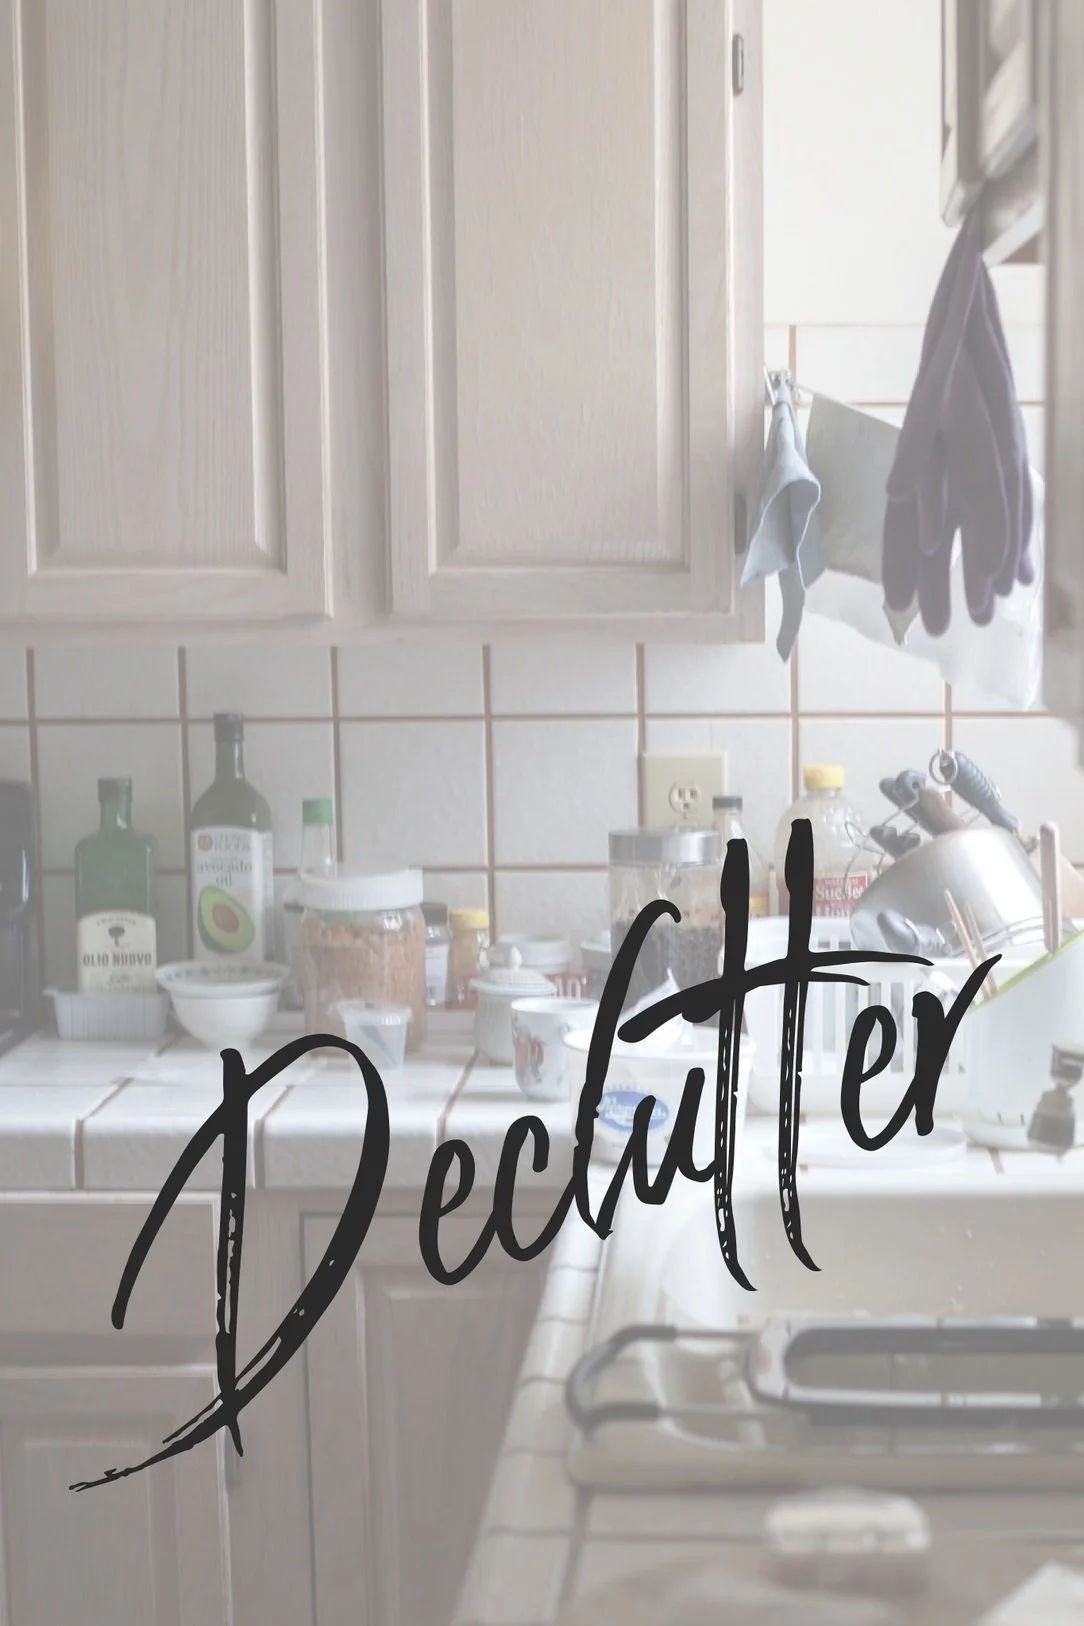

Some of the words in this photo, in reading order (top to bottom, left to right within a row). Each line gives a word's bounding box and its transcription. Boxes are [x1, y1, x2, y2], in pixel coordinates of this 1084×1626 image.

[197, 860, 253, 874] avocado
[82, 952, 109, 967] OLIO
[112, 952, 152, 967] NUOVO
